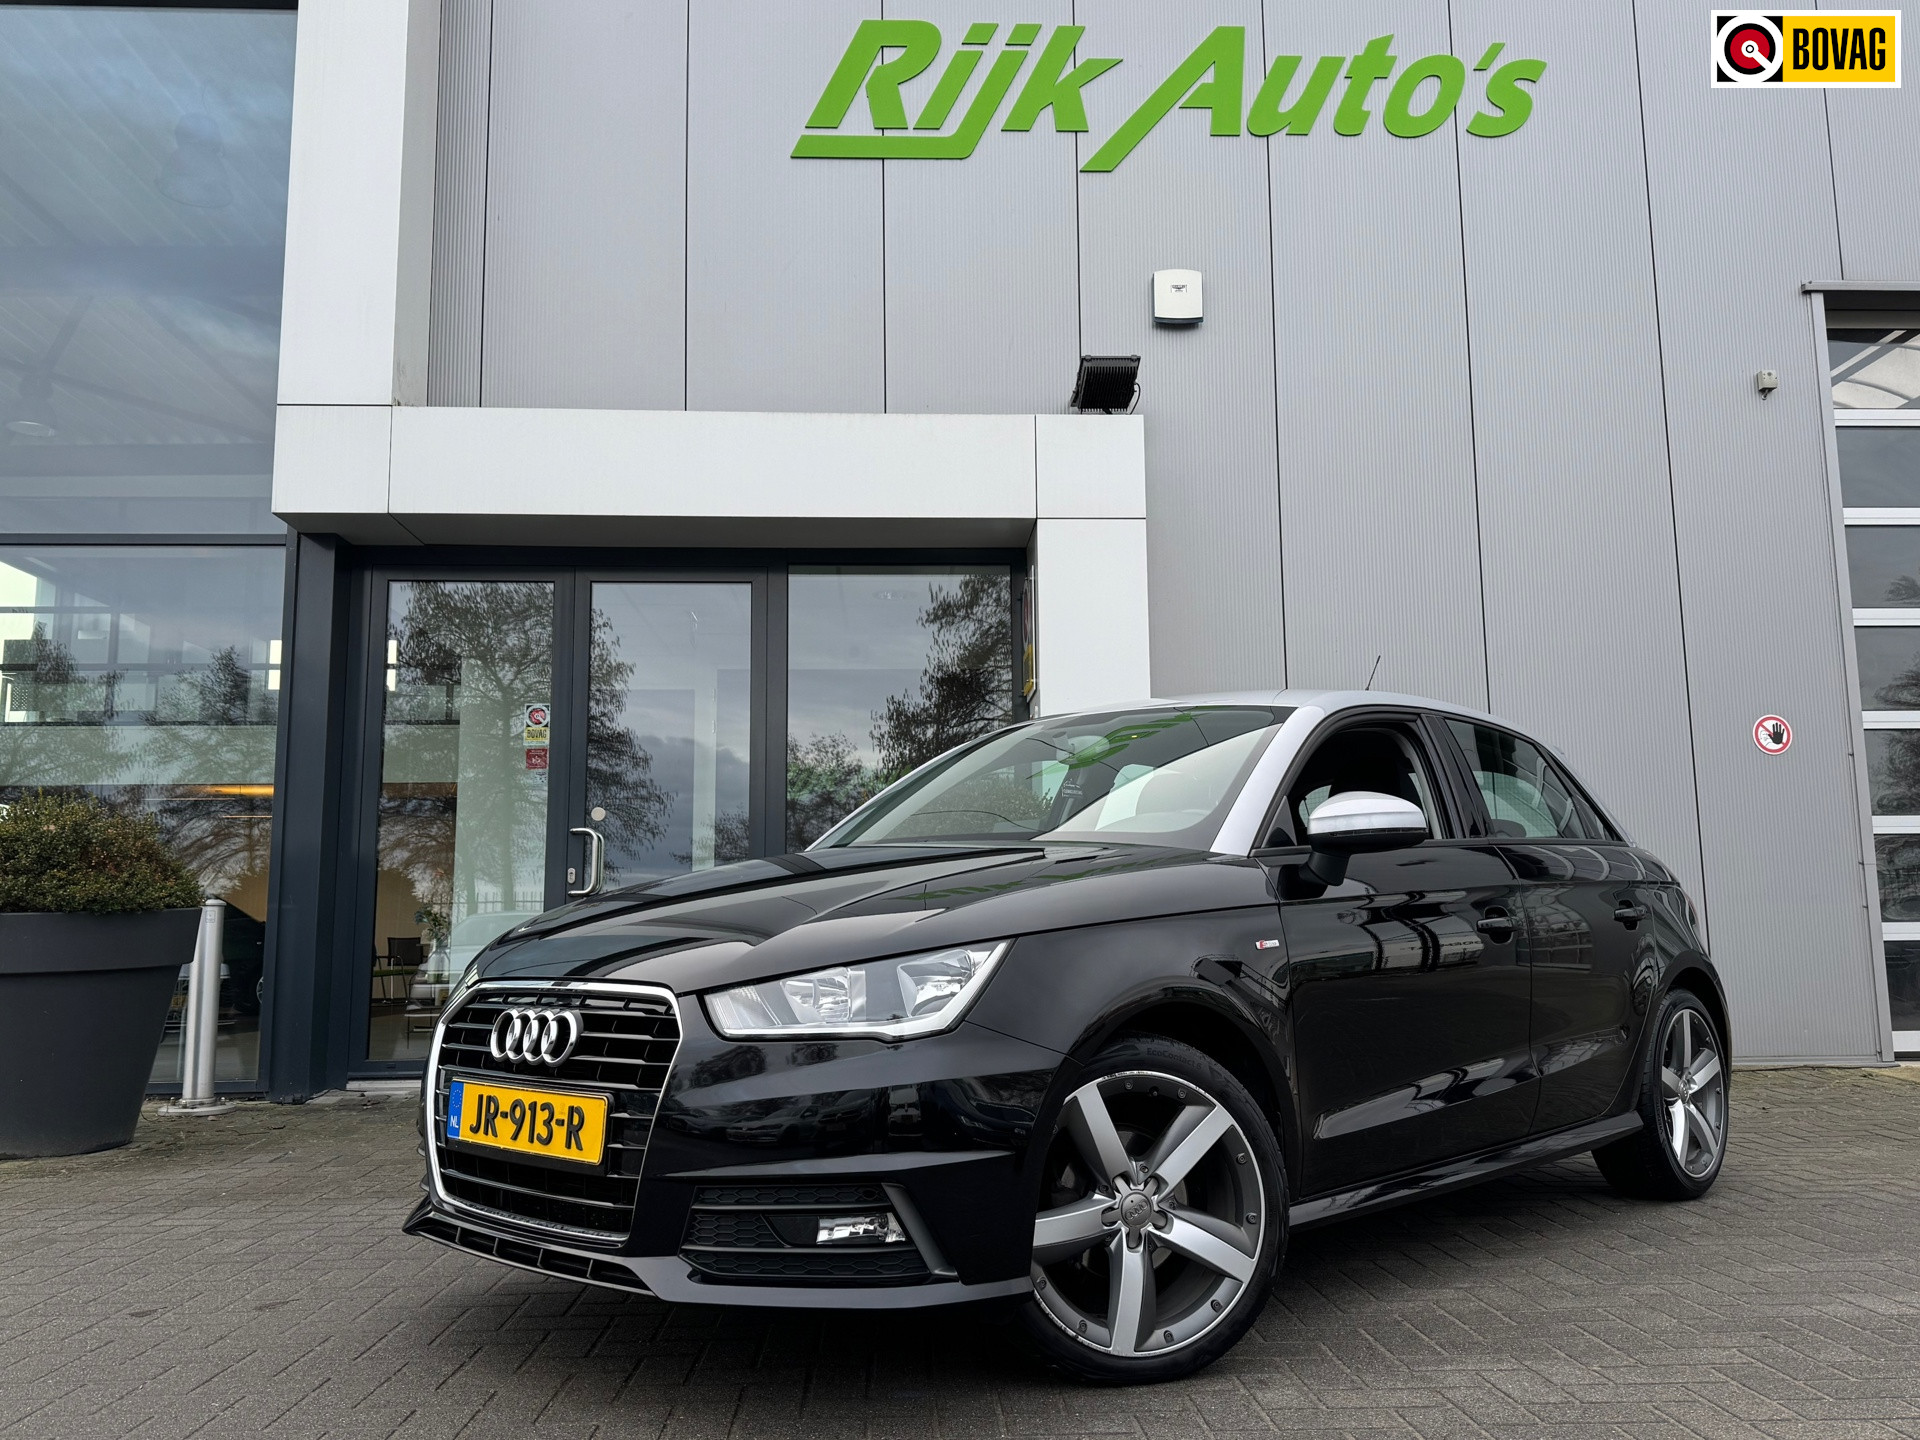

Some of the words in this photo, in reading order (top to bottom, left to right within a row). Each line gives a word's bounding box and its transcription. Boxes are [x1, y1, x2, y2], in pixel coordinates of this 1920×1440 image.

[791, 20, 1123, 160] Rijk
[1080, 25, 1548, 172] Auto's
[526, 729, 547, 739] BOVAG
[1146, 1047, 1196, 1068] EcoContact
[450, 1115, 459, 1129] NL
[469, 1093, 585, 1151] JR-913-R
